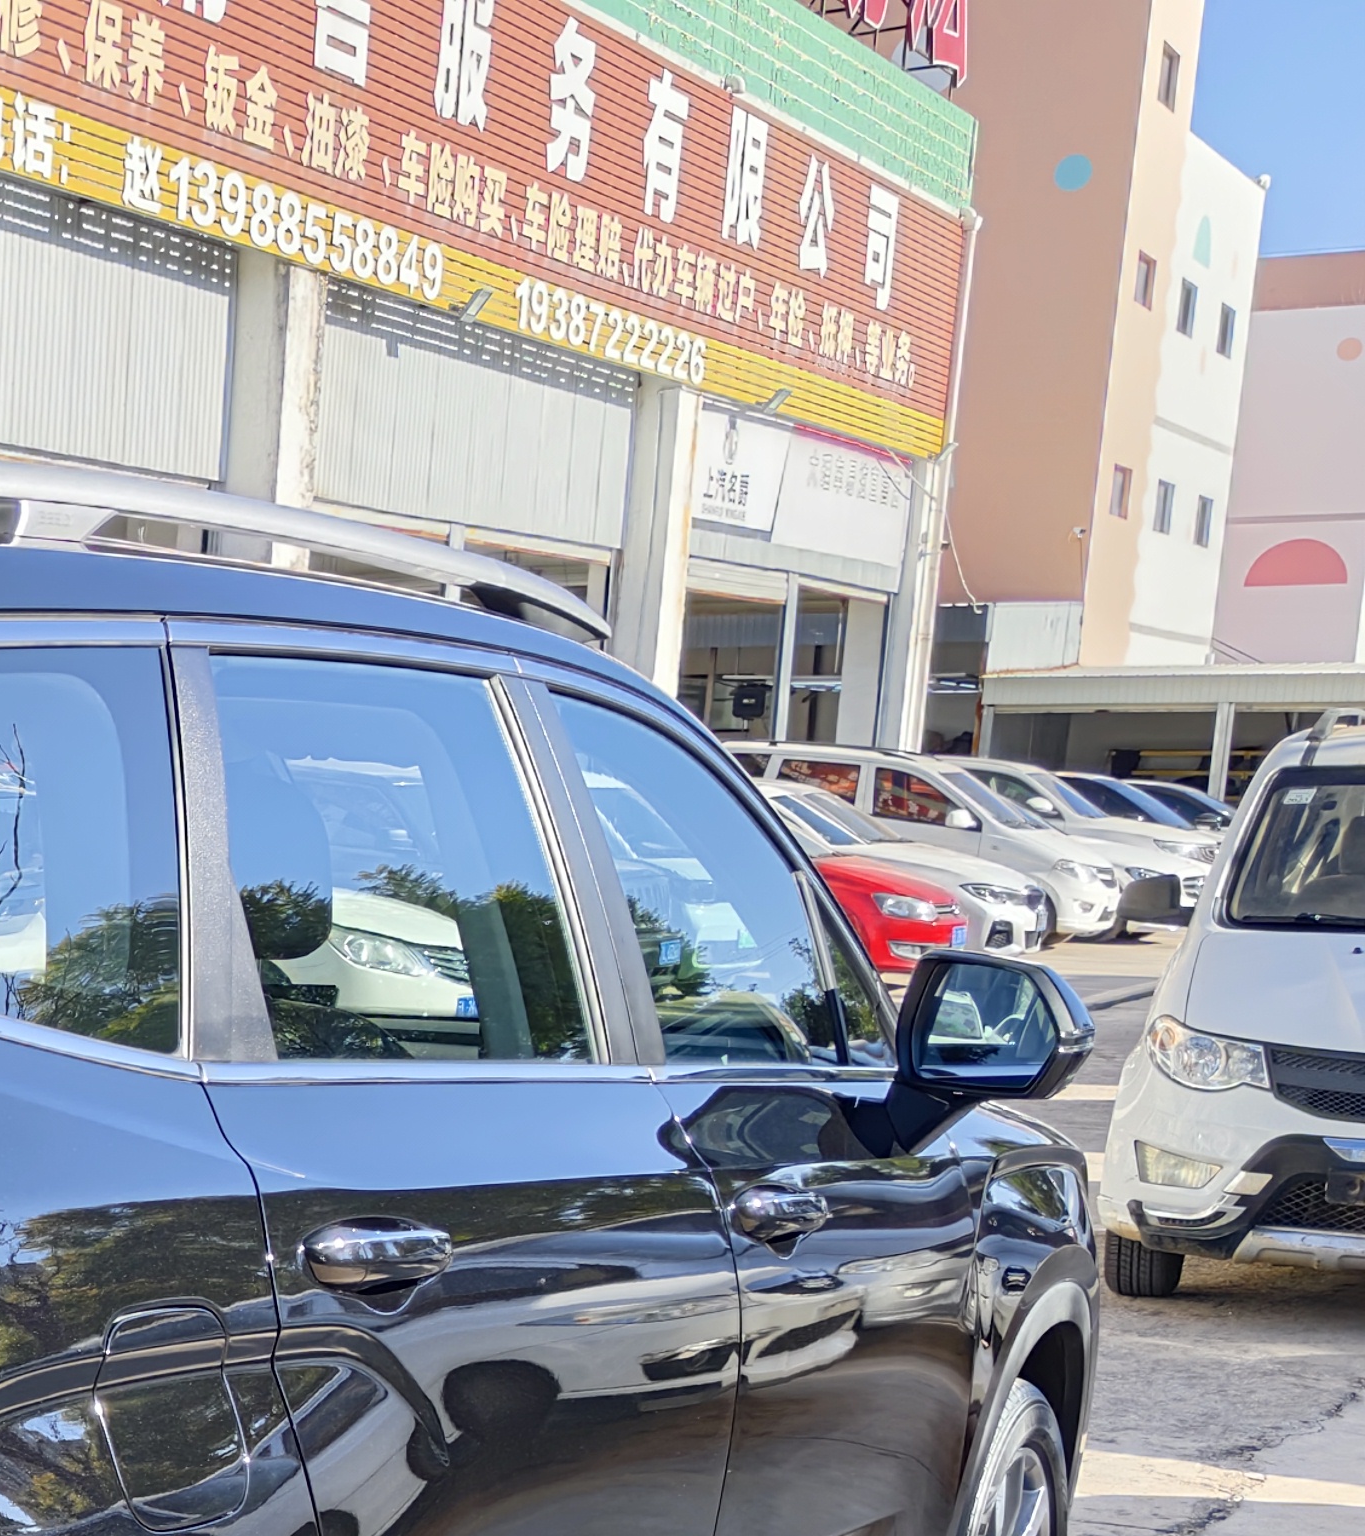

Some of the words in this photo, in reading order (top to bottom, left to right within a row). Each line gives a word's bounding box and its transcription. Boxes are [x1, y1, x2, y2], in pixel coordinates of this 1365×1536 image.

[157, 0, 901, 311] 服务有限公司
[515, 276, 707, 386] 19387222226
